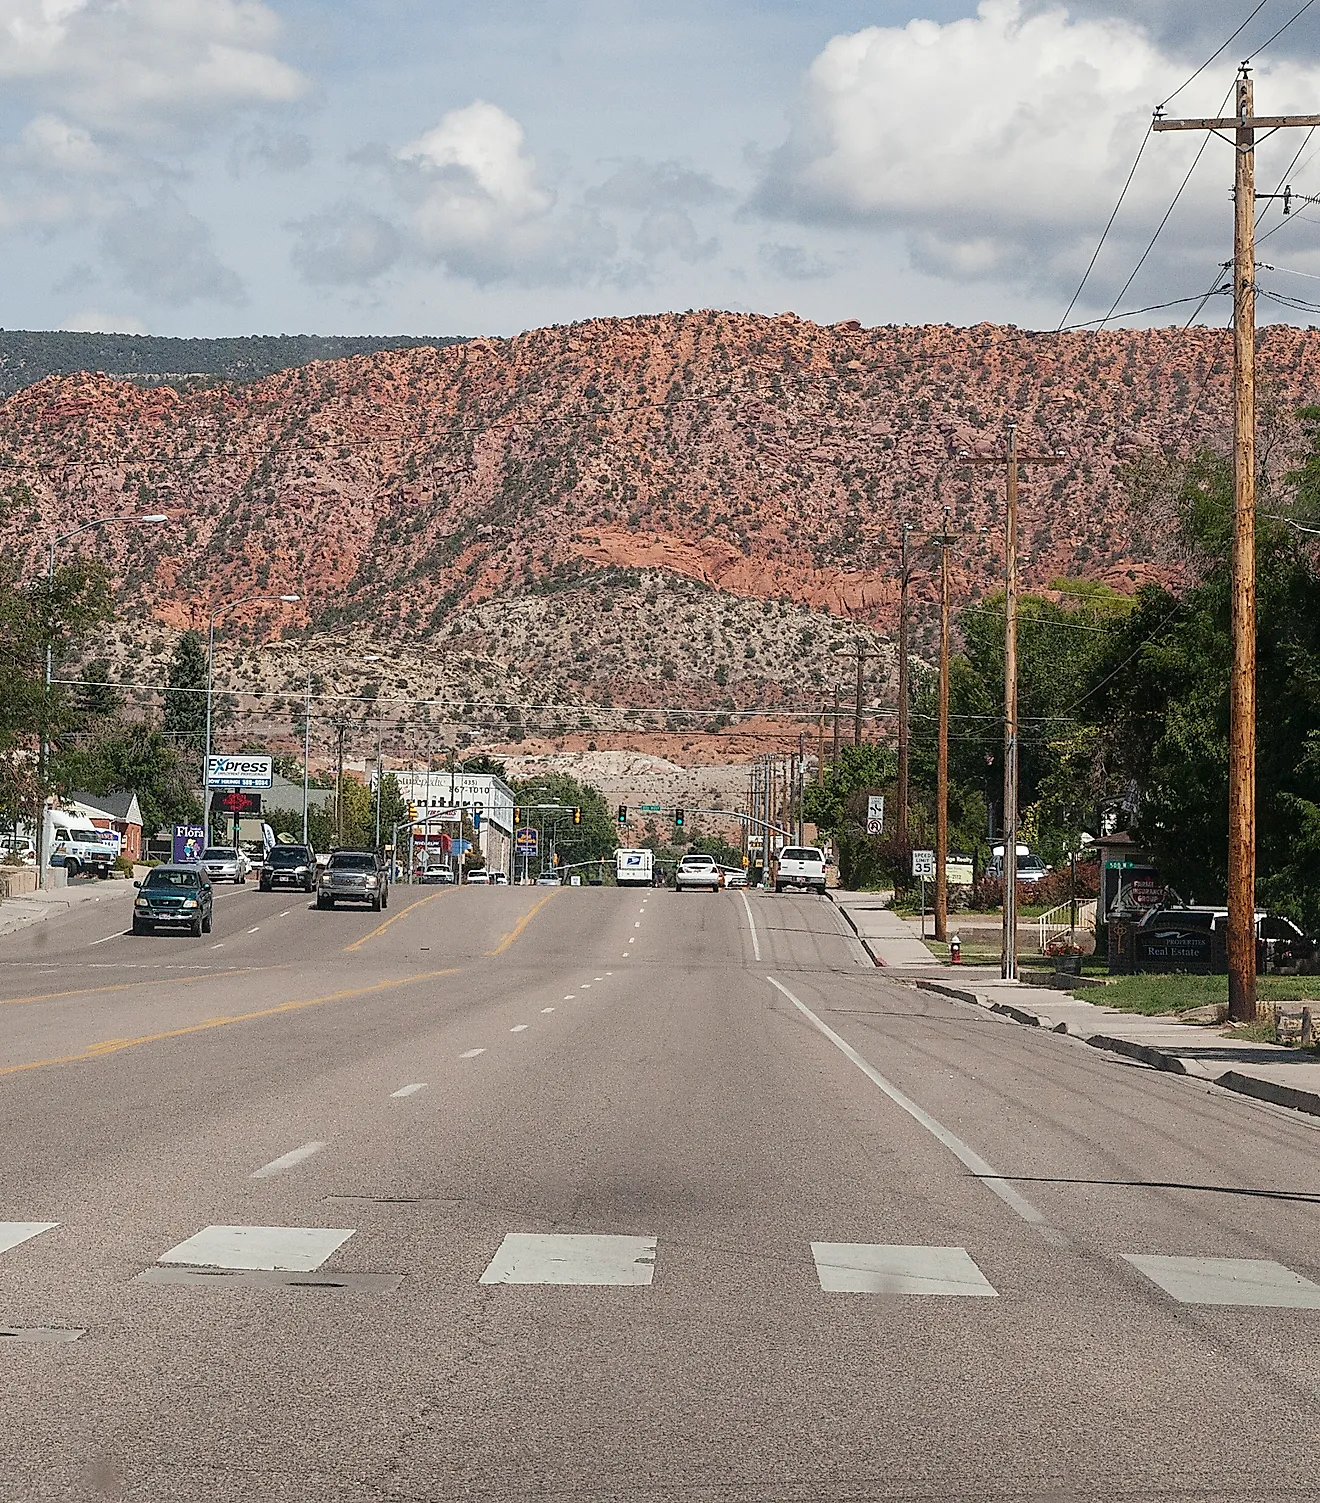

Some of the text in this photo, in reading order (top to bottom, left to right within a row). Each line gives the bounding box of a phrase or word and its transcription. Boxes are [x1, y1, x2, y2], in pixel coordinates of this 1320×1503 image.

[208, 758, 269, 774] Express
[176, 826, 204, 838] Flora
[915, 863, 931, 873] 35
[1148, 946, 1200, 957] Real Estate
